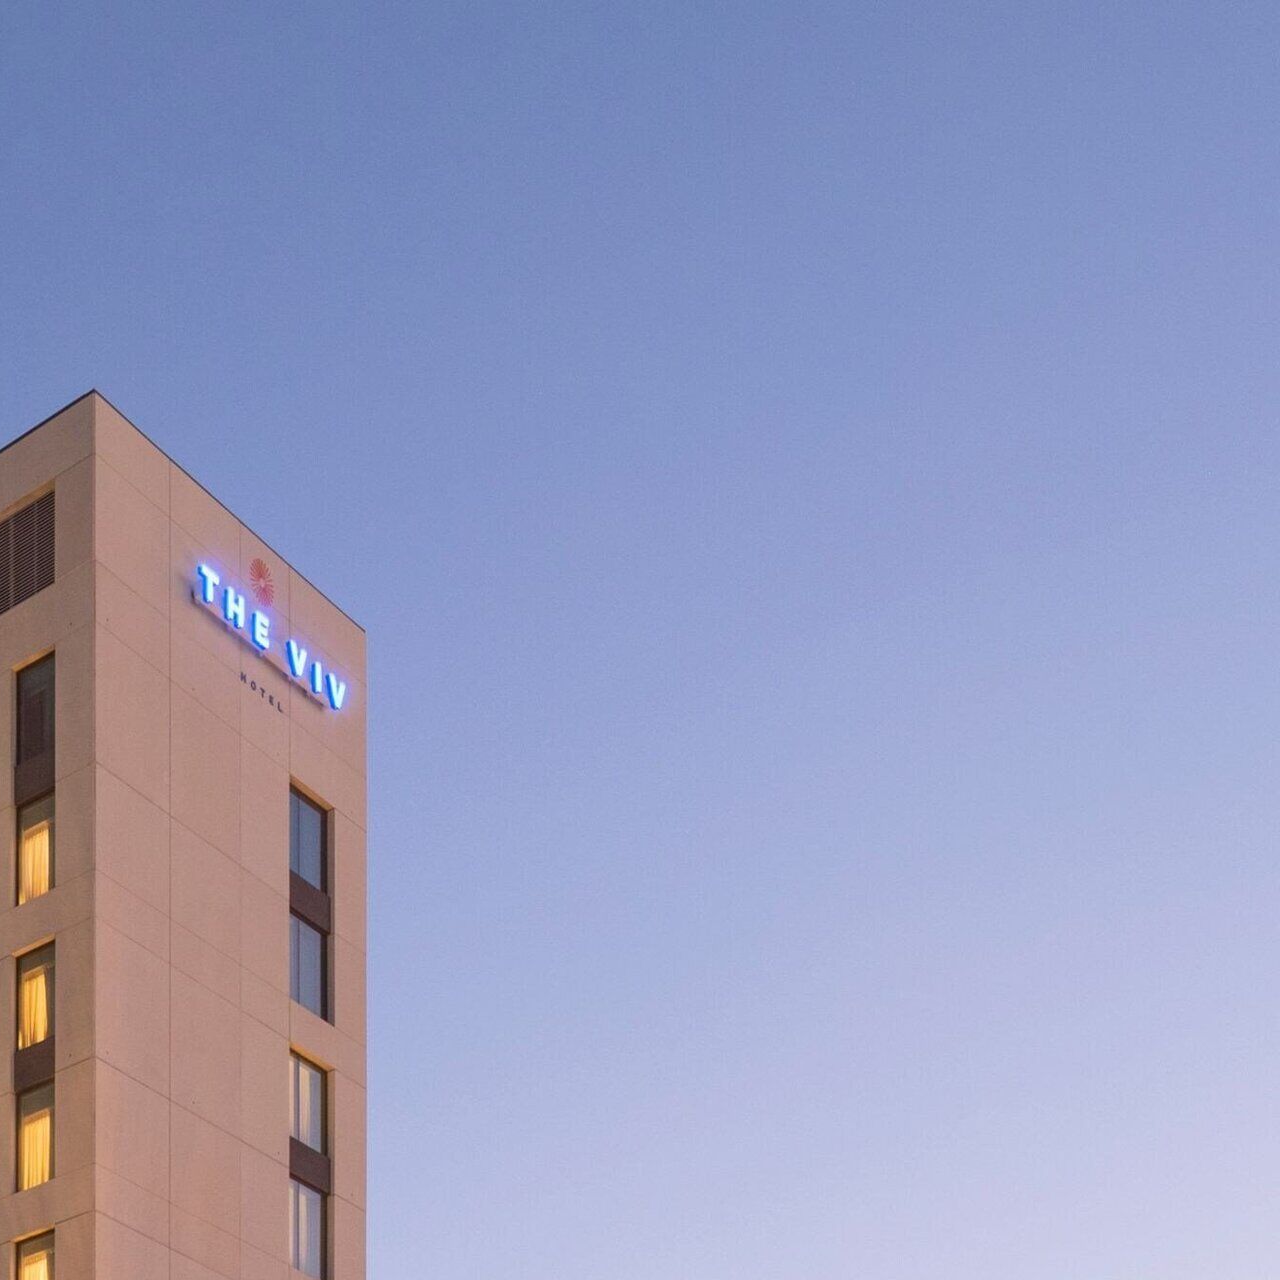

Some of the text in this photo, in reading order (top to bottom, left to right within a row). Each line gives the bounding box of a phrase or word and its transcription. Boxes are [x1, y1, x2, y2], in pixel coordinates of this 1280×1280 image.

[196, 563, 346, 711] THE VIV
[240, 671, 284, 713] HOTEL
